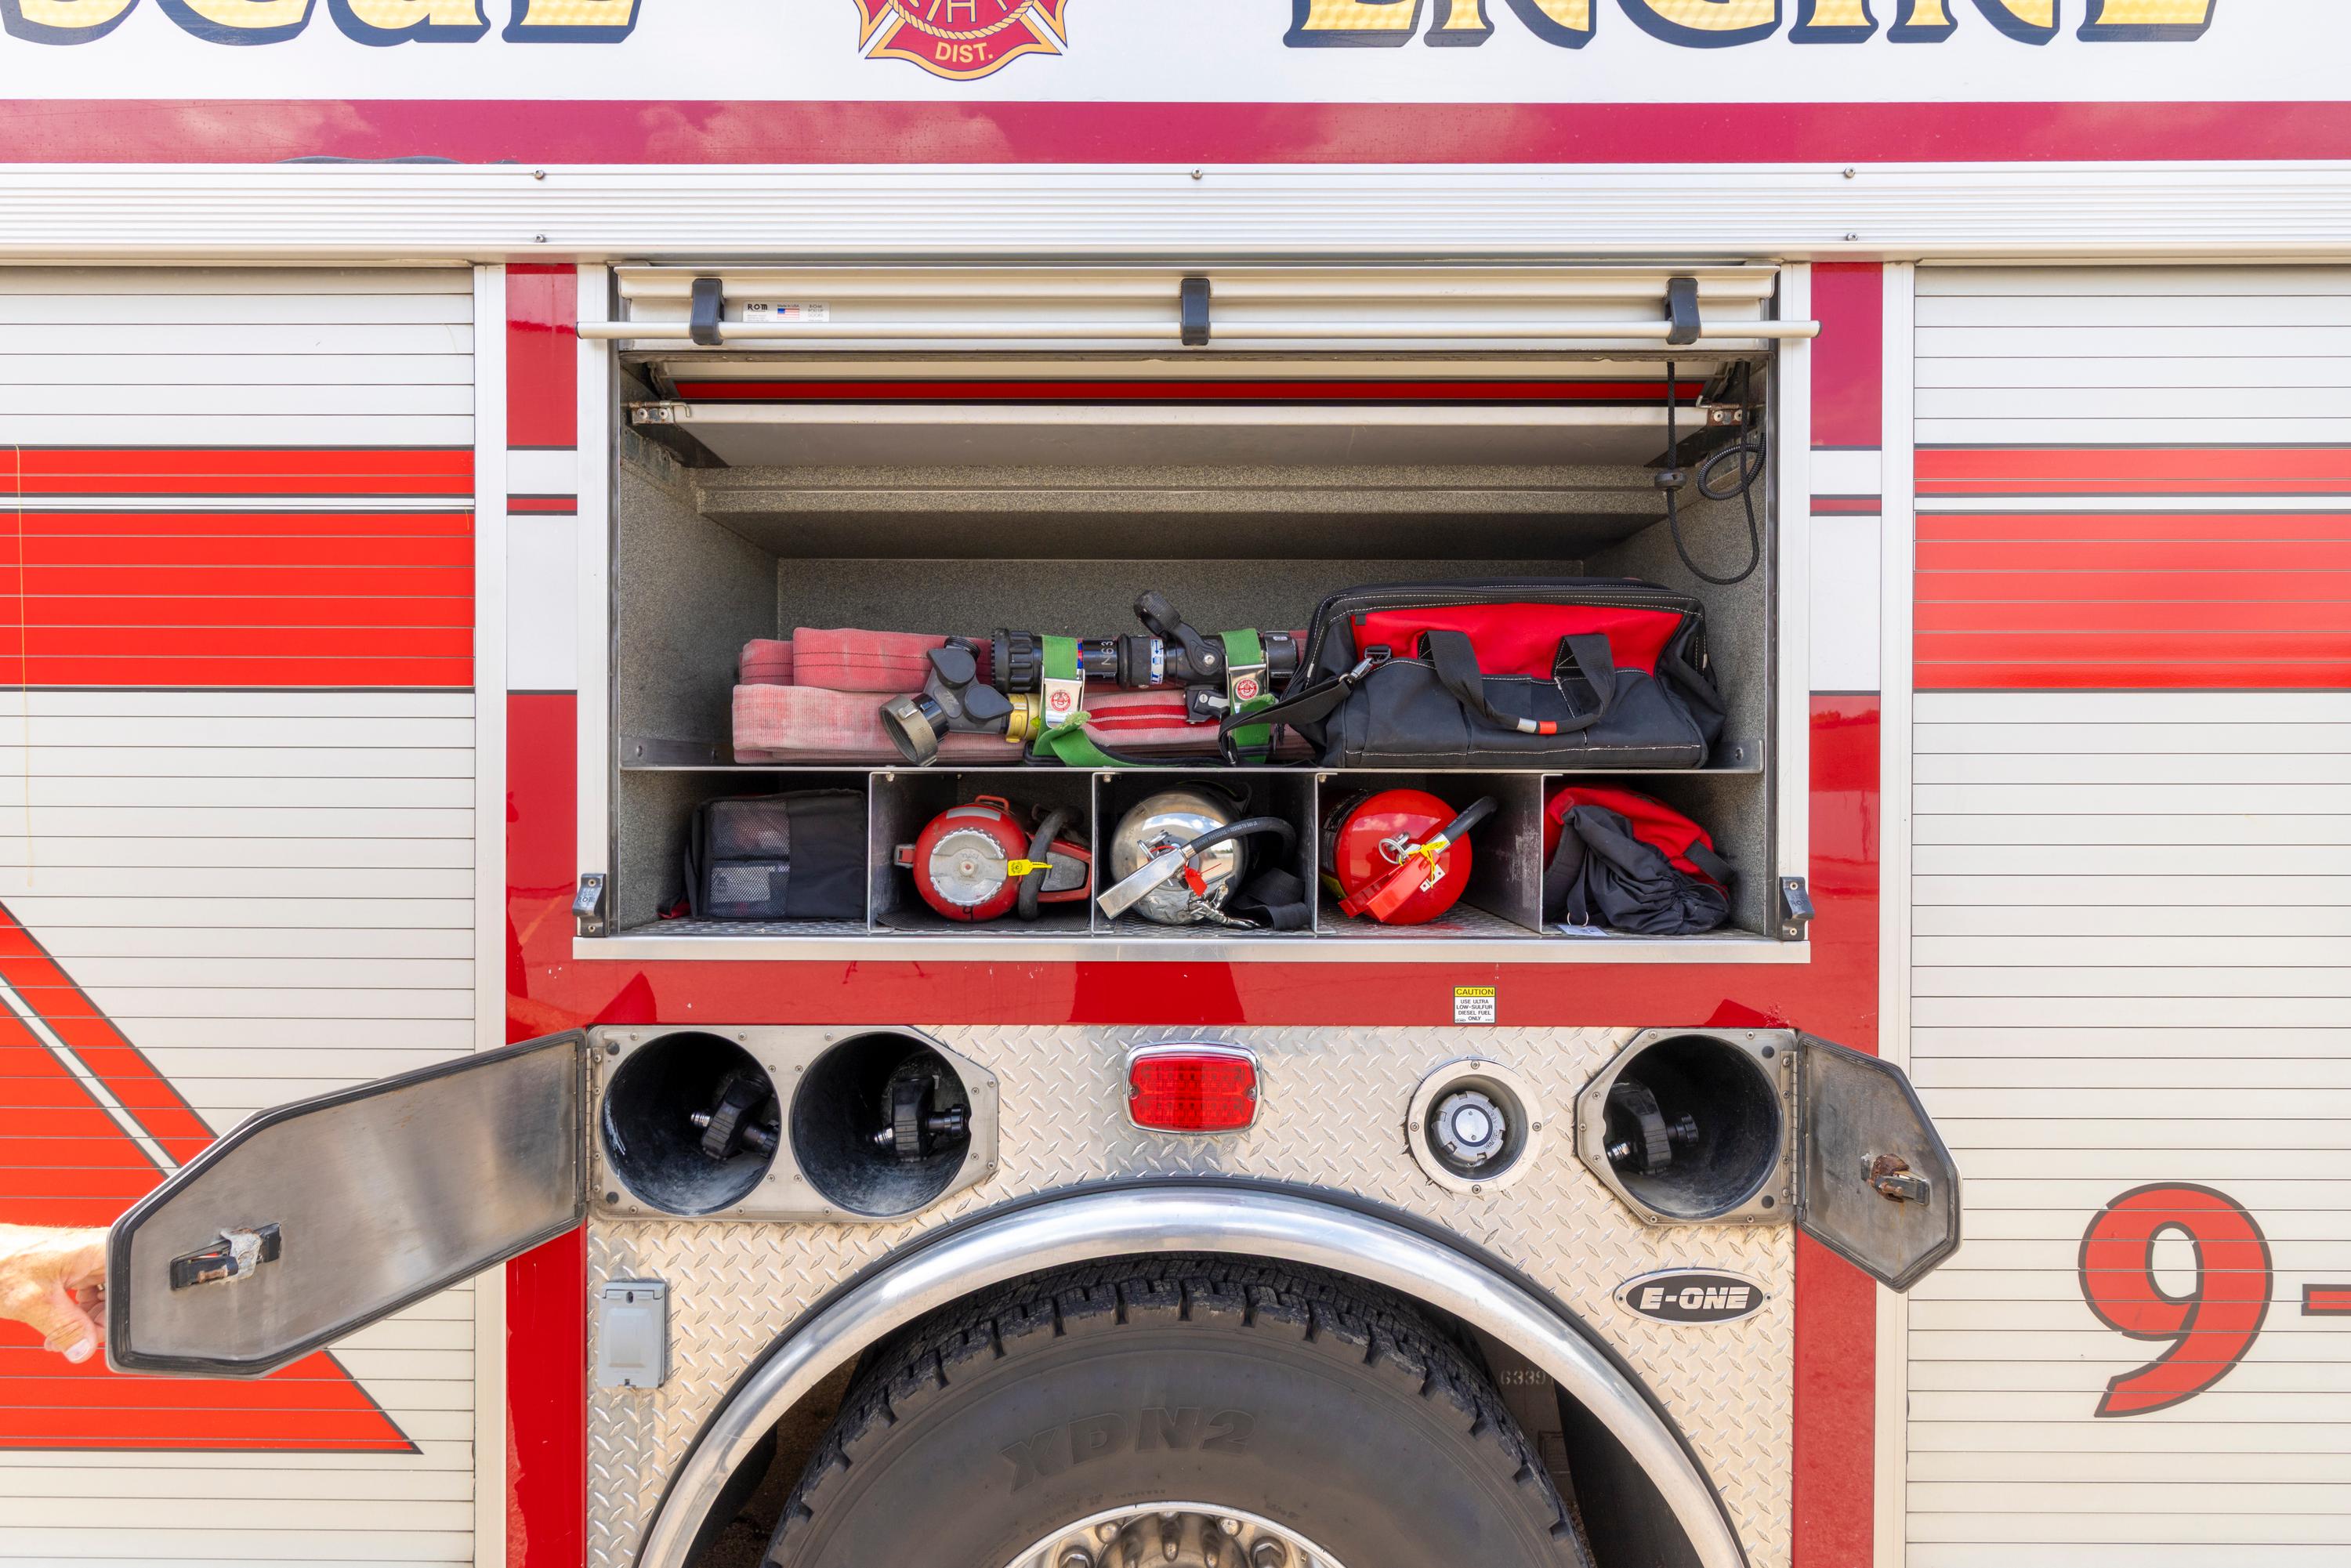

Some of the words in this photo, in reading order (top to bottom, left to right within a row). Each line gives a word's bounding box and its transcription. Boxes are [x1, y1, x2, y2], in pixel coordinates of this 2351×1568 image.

[935, 42, 994, 63] DIST.
[1639, 1286, 1750, 1309] E-ONE
[998, 1407, 1255, 1494] XDN2
